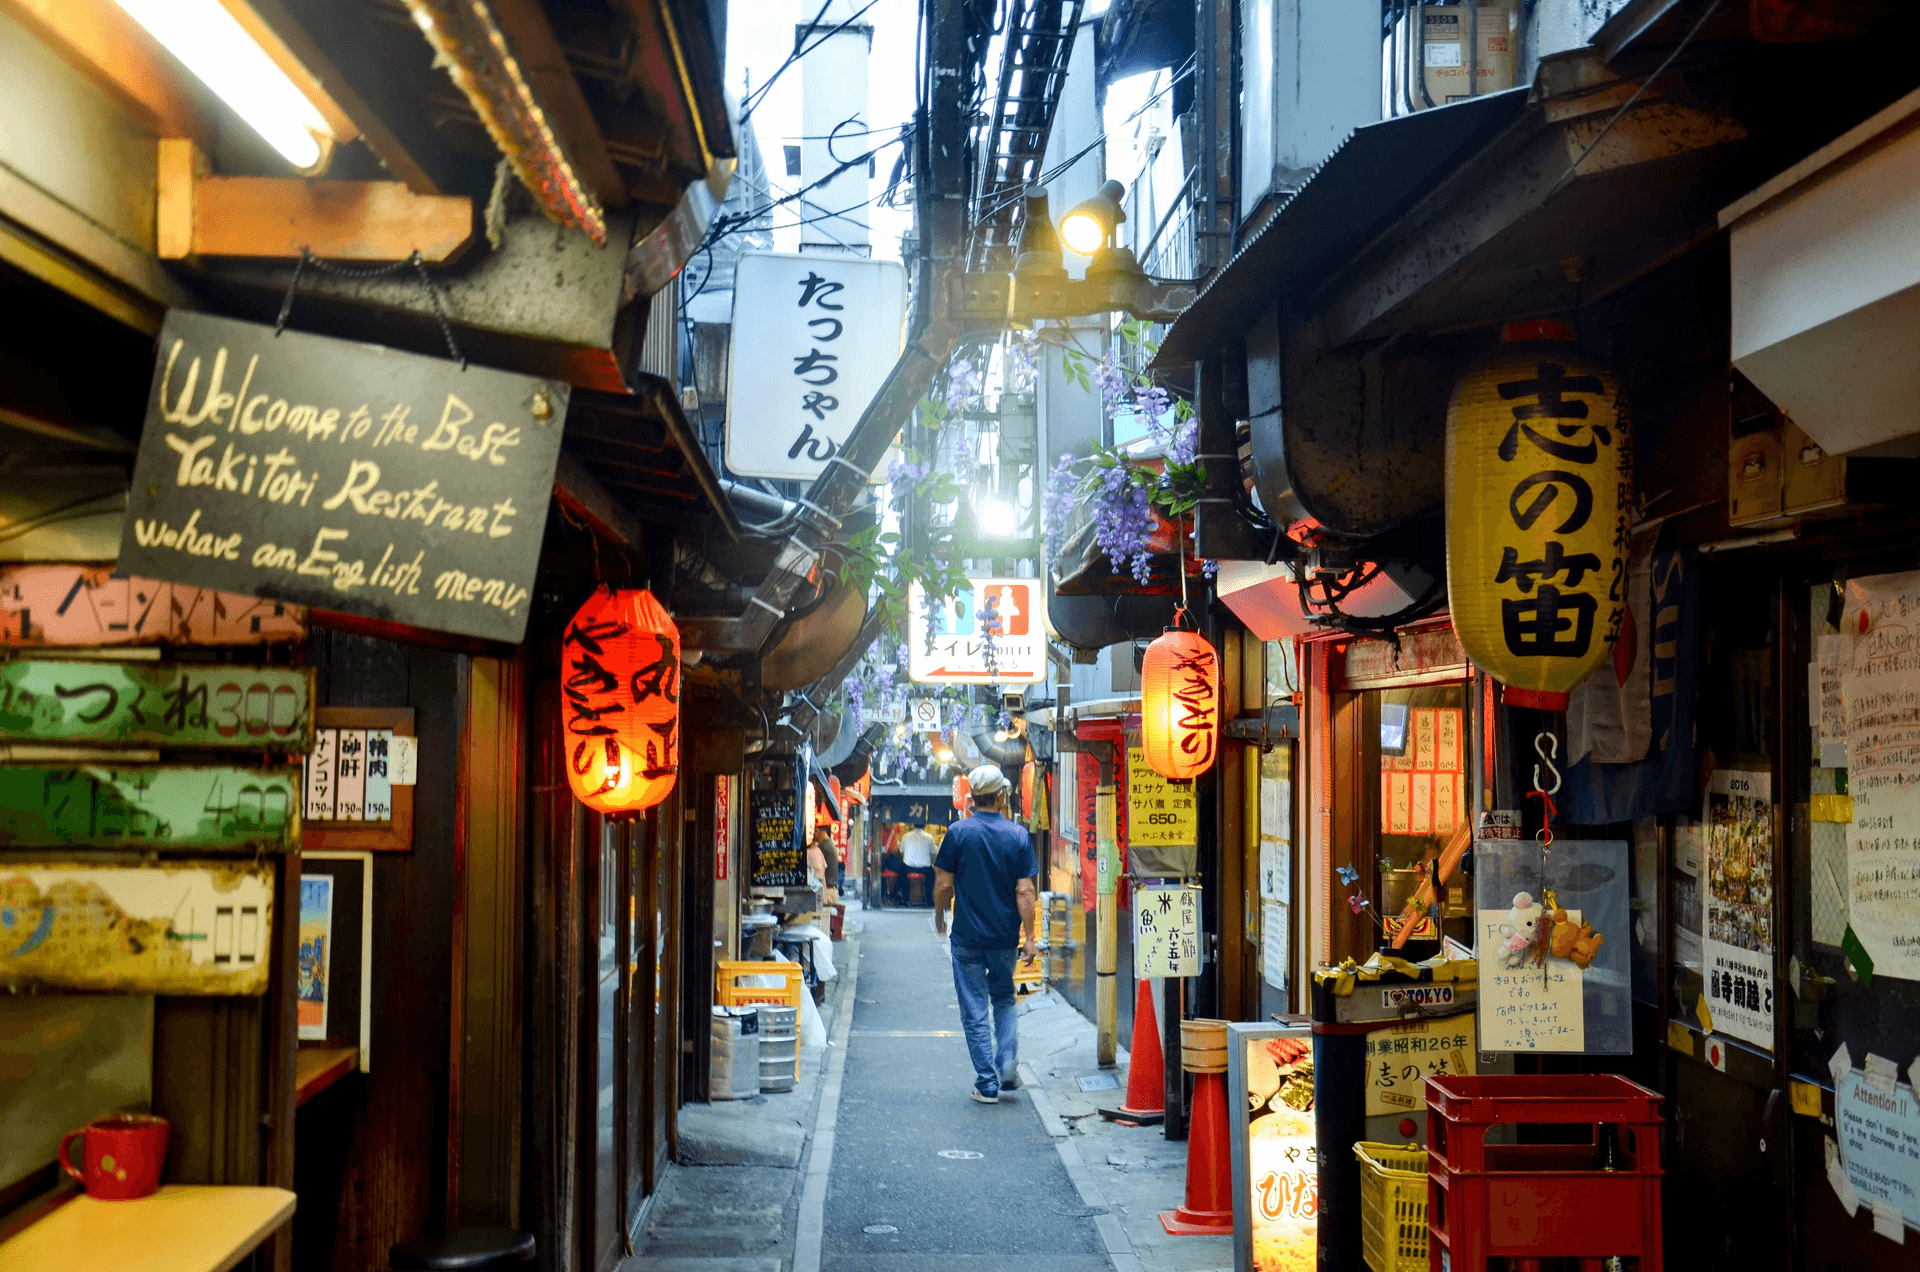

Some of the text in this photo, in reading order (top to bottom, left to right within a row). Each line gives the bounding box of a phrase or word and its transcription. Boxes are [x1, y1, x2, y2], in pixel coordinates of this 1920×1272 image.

[160, 339, 521, 466] Welcome to the Best
[1494, 363, 1612, 659] 志の笛
[54, 675, 300, 738] つくね 300
[1170, 649, 1215, 768] やきとり
[340, 738, 361, 777] 砂肝
[368, 738, 388, 778] 精肉
[1730, 779, 1750, 791] 2016
[1149, 813, 1177, 825] 650
[1173, 798, 1192, 809] 定食
[1383, 987, 1452, 1007] I TOKYO
[1853, 1083, 1897, 1114] Attention
[1843, 1109, 1862, 1125] Please
[1885, 1126, 1899, 1140] stop
[1857, 1127, 1867, 1139] the
[1870, 1132, 1895, 1152] doorway
[1908, 1146, 1919, 1160] the
